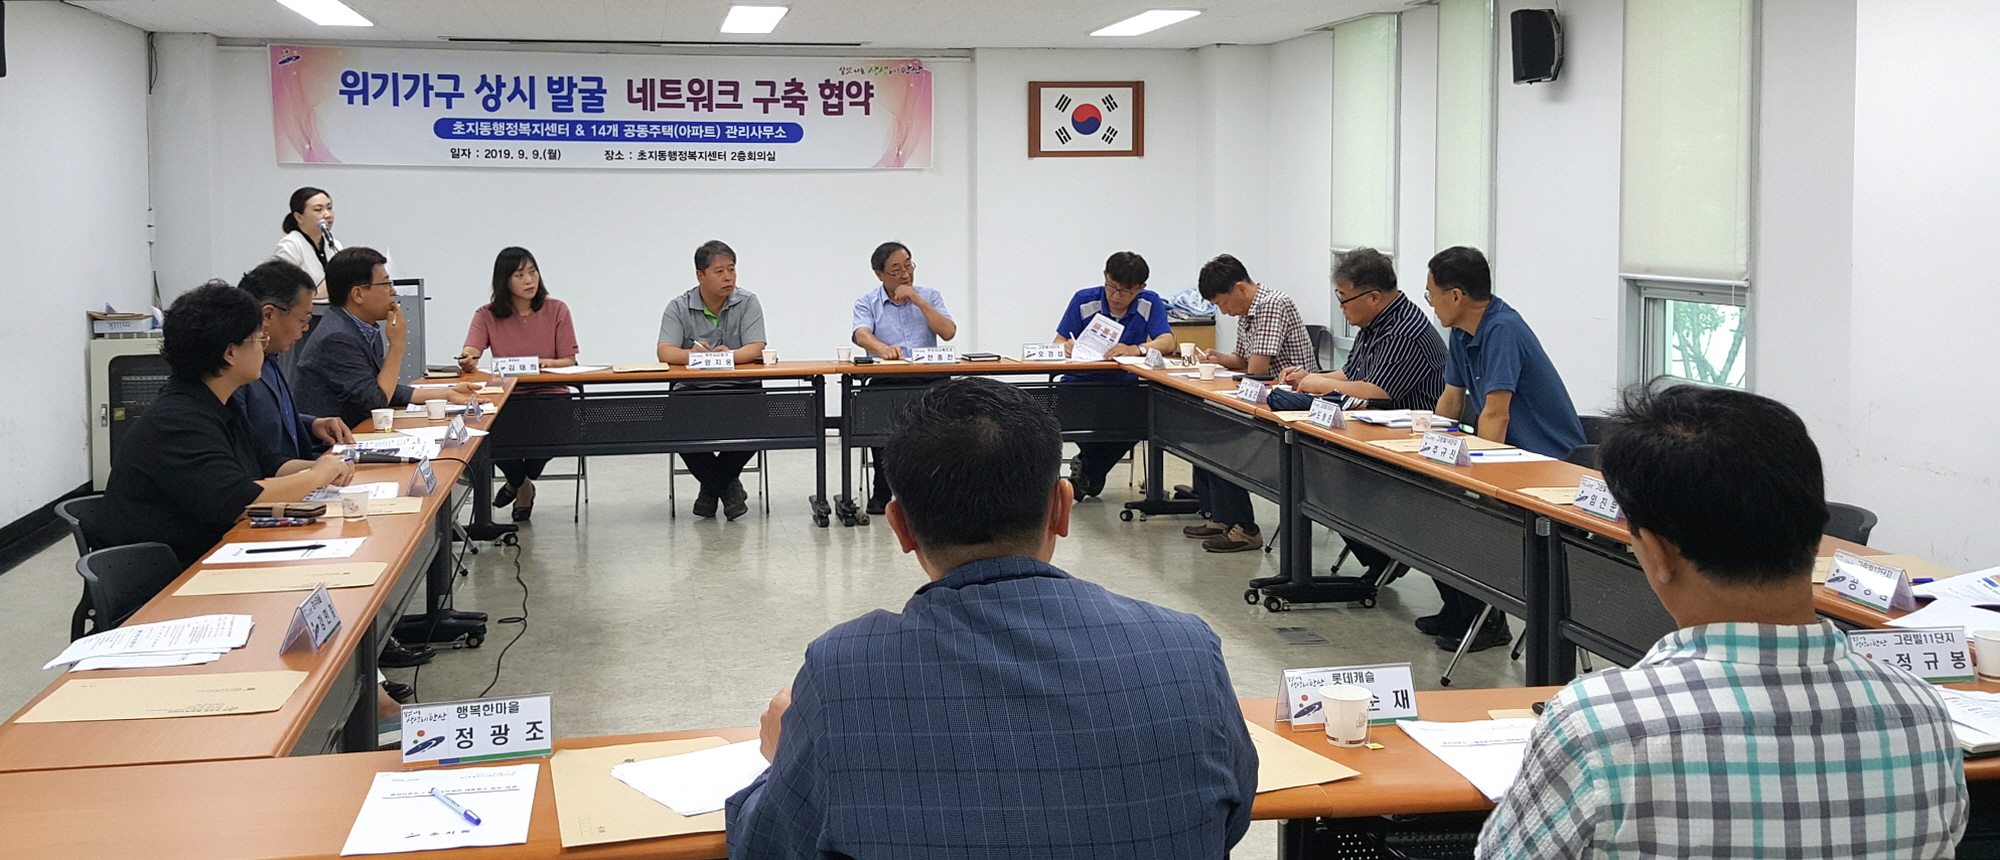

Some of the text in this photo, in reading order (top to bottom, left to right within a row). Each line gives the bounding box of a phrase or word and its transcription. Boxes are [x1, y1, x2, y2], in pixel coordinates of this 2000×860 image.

[339, 70, 874, 116] 위기가구 상시 발굴 네트워크 구축 협약
[452, 121, 787, 139] 초지동행정복지센터 & 14개 공동주택(아파트) 관리사무소
[450, 148, 471, 159] 일자
[484, 149, 514, 160] 2019.
[518, 150, 528, 160] 9.
[604, 150, 625, 161] 장소
[637, 150, 727, 162] 초지동행정복지센터
[731, 151, 776, 162] 2층회의실
[1893, 632, 1955, 645] 그린빌11단지
[1331, 671, 1375, 685] 롯데캐슬
[456, 701, 520, 719] 행복한마을
